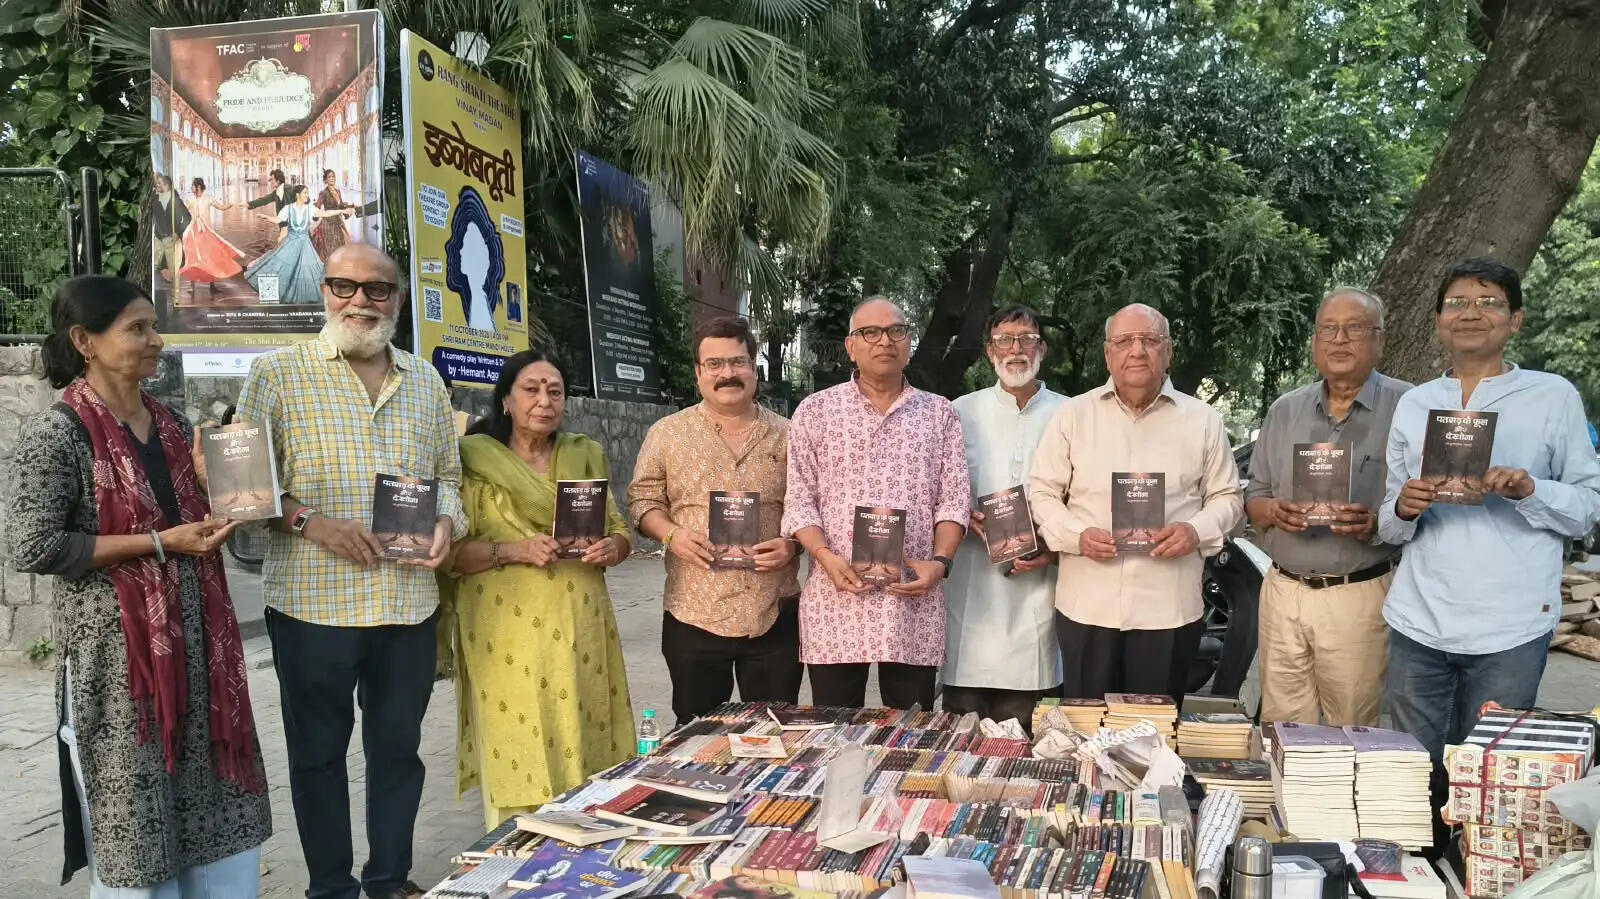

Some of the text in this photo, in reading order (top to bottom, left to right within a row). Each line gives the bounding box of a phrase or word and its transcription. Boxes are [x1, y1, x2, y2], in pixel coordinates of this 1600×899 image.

[216, 44, 245, 56] TFAC
[437, 65, 459, 88] RANG
[460, 79, 486, 104] SHAKTI
[223, 98, 245, 106] PRIDE
[246, 97, 263, 105] AND
[455, 97, 477, 115] VINAY
[478, 109, 503, 131] MADAN
[455, 326, 478, 336] OCTOBER
[467, 339, 485, 348] CENTRE
[446, 353, 466, 363] comedy
[467, 355, 477, 364] play
[477, 356, 495, 365] Written
[448, 364, 457, 376] by
